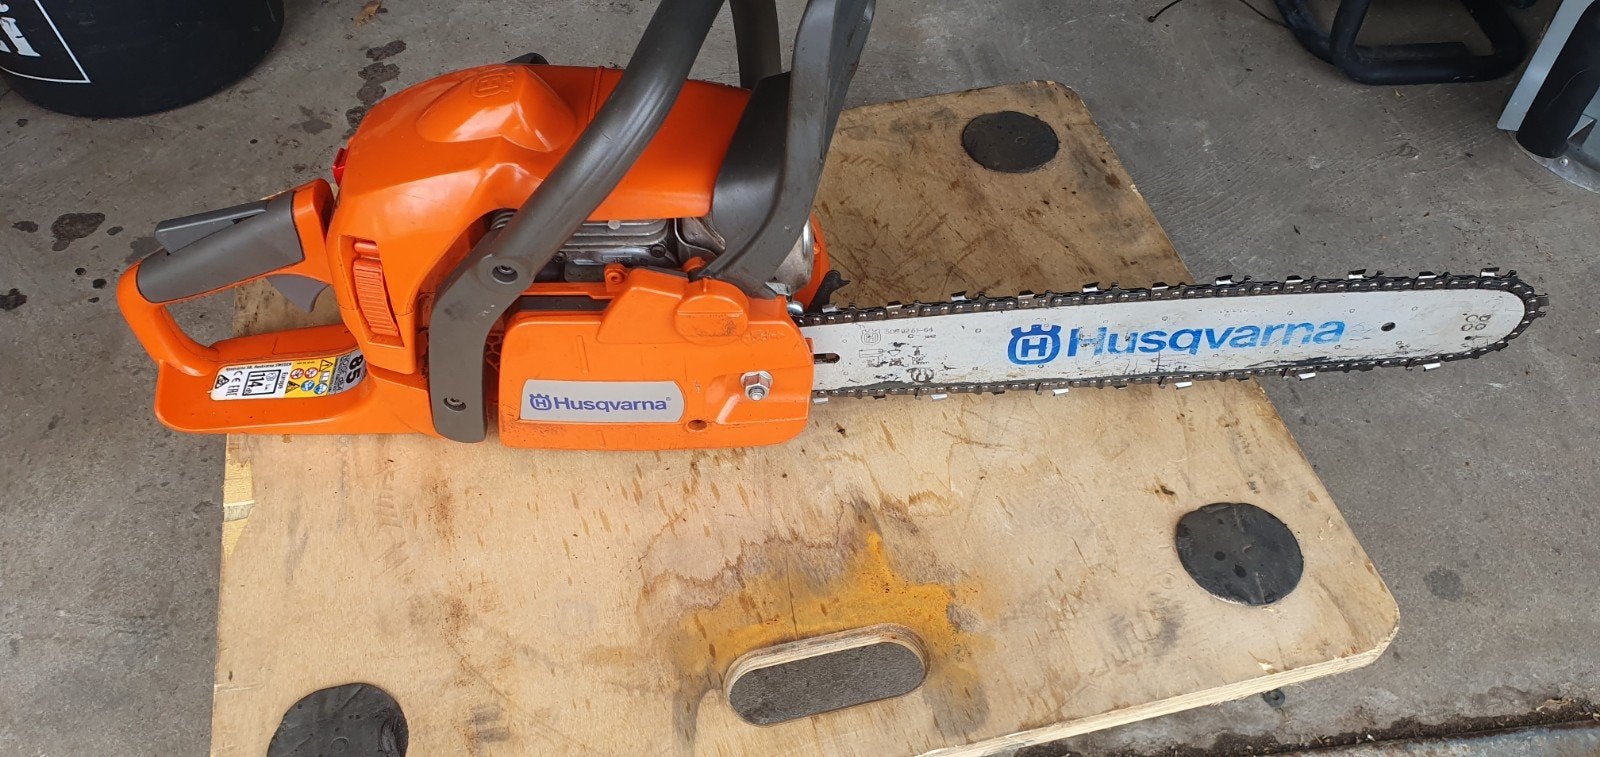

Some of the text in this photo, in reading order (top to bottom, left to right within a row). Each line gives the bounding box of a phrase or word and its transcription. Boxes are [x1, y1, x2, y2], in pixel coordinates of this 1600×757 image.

[1066, 320, 1346, 357] Husqvarna
[247, 373, 266, 388] 114
[346, 354, 364, 384] 85
[554, 396, 668, 413] Husqvarna
